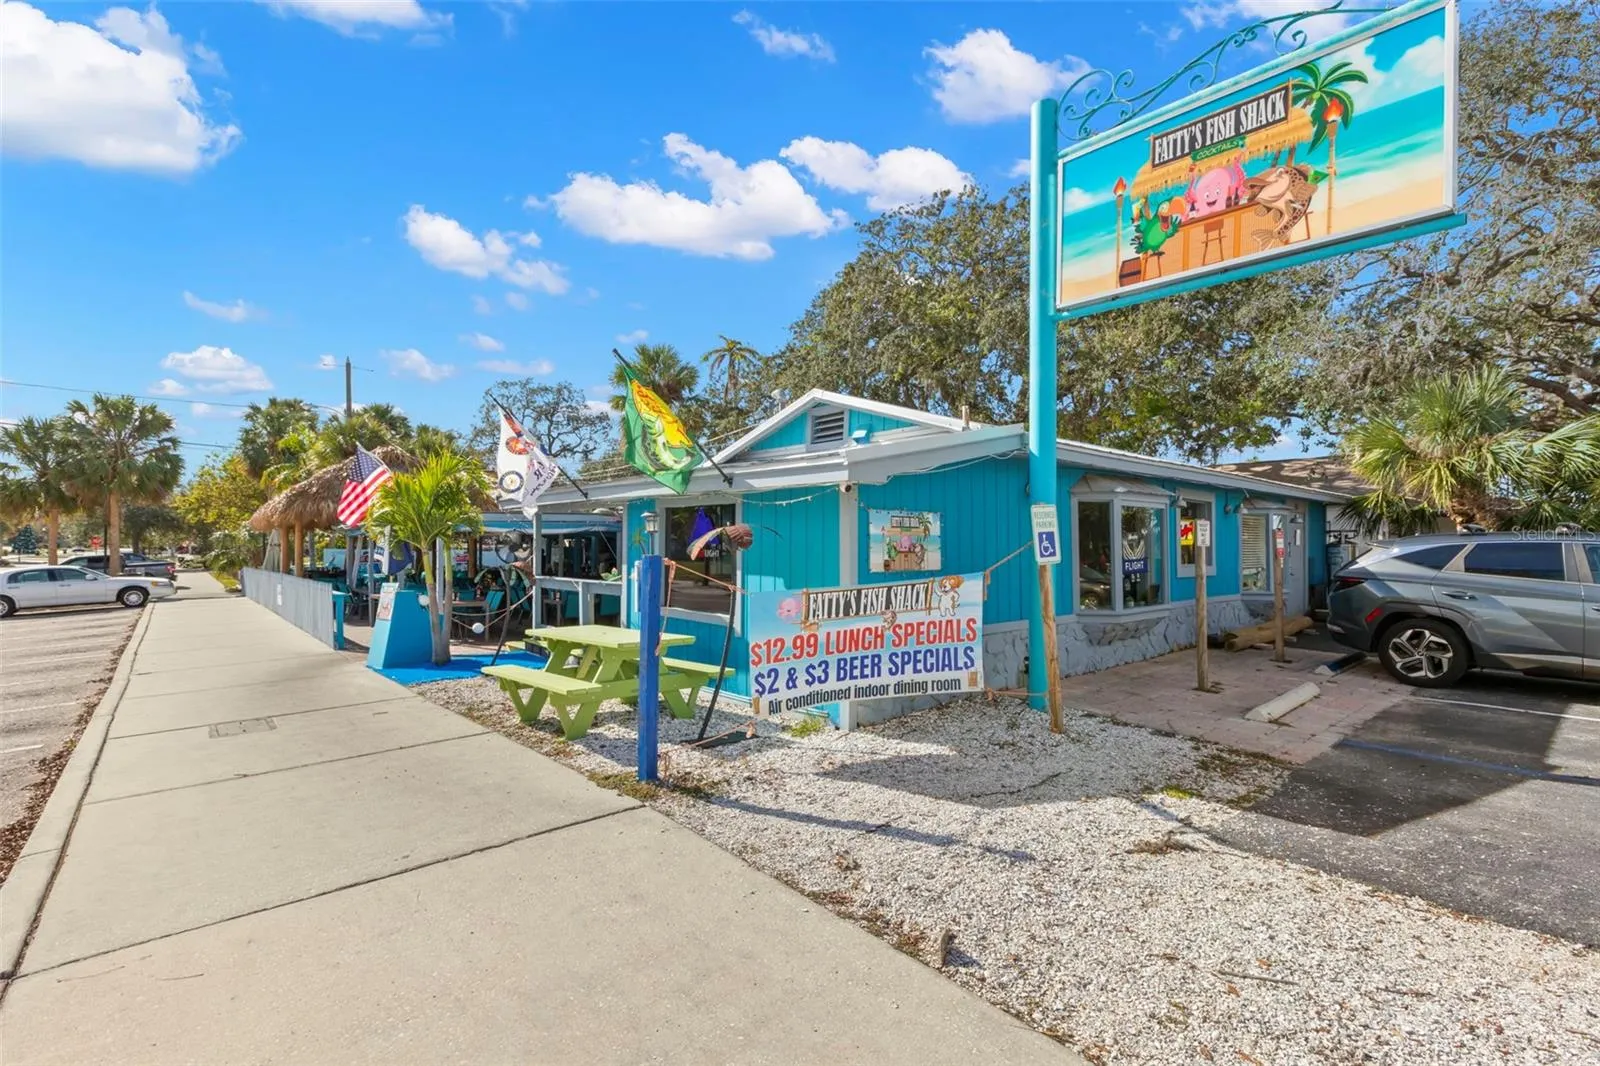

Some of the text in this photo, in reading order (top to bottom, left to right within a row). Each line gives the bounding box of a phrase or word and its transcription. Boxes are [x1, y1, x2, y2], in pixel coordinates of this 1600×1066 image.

[1154, 89, 1287, 165] FATTY'S FISH SHACK
[1196, 140, 1237, 159] COCKTAILS
[1124, 560, 1145, 571] FLIGHT
[809, 583, 928, 621] FATTY'S FISH SHACK
[750, 617, 978, 668] $12.99 LUNCH SPECIALS
[754, 645, 975, 698] $2 & $3 BEER SPECIALS
[768, 678, 961, 716] Air conditioned indoor dining room
